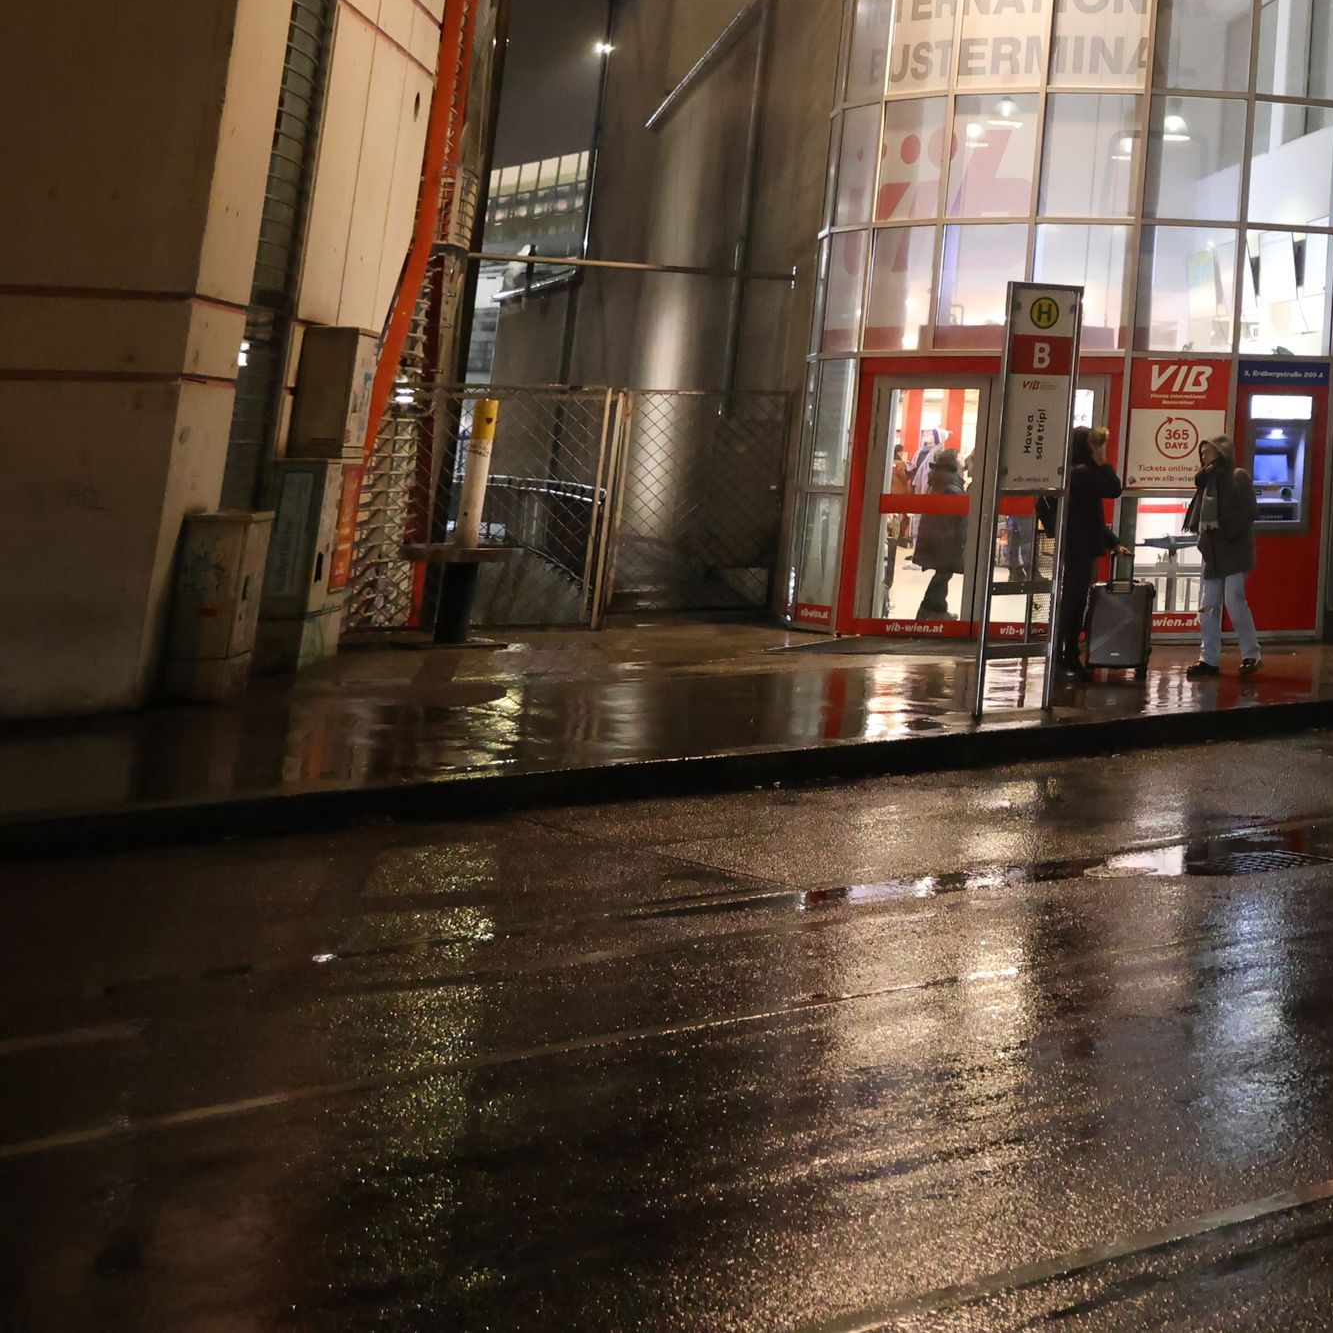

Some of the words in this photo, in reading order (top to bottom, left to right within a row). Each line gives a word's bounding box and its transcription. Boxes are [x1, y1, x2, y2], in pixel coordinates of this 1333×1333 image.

[1037, 303, 1053, 322] H
[1033, 342, 1051, 368] B
[1023, 380, 1040, 391] VIB
[1150, 364, 1213, 393] VIB
[1023, 423, 1034, 454] Have
[1164, 429, 1189, 440] 365
[1036, 434, 1047, 460] safe
[1165, 442, 1189, 450] DAYS
[886, 622, 944, 634] vib-wien.at
[1152, 616, 1199, 627] wien.at
